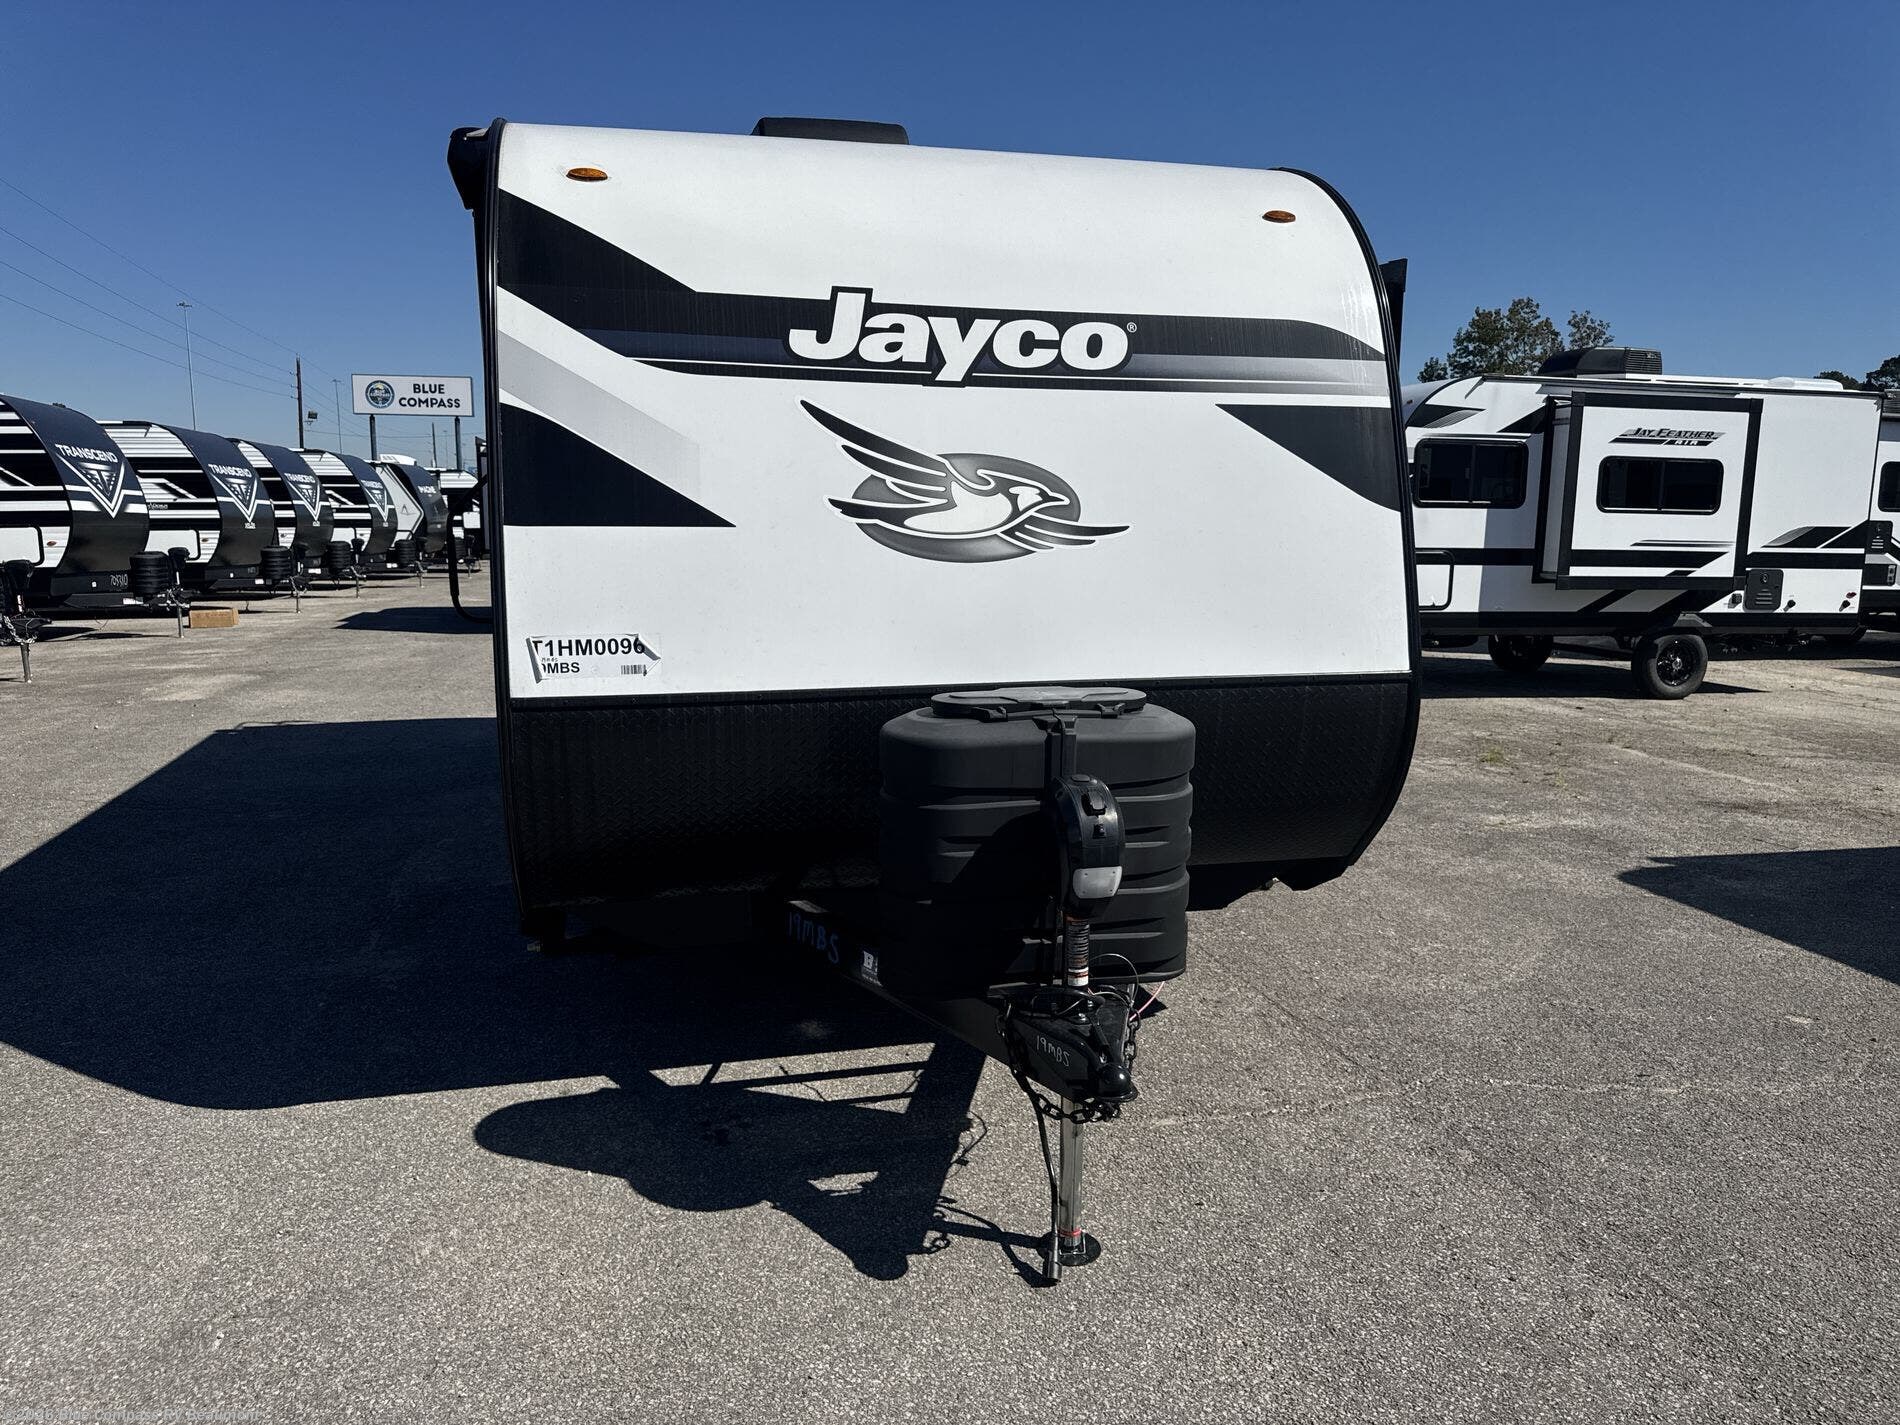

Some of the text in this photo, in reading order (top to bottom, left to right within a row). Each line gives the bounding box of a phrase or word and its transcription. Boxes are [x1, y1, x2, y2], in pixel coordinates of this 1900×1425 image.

[413, 383, 445, 394] BLUE
[398, 397, 461, 408] COMPASS
[55, 443, 119, 463] TRANSCEND
[207, 463, 253, 478] TRANSCEND
